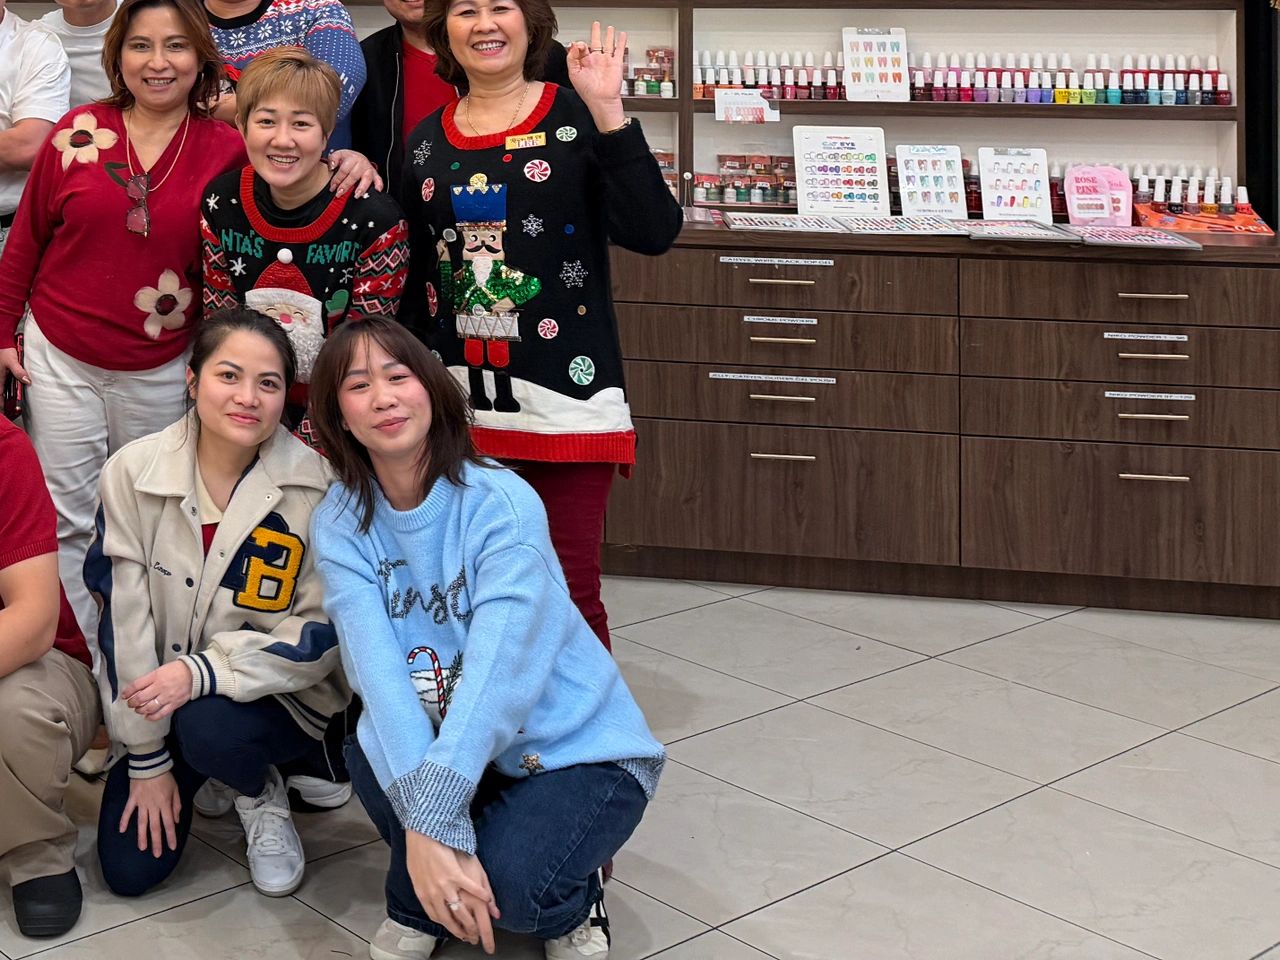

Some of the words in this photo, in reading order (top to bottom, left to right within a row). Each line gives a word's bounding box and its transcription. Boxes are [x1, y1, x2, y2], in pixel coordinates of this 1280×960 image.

[1074, 176, 1098, 184] ROSE
[1076, 185, 1099, 194] PINK
[236, 526, 305, 611] B
